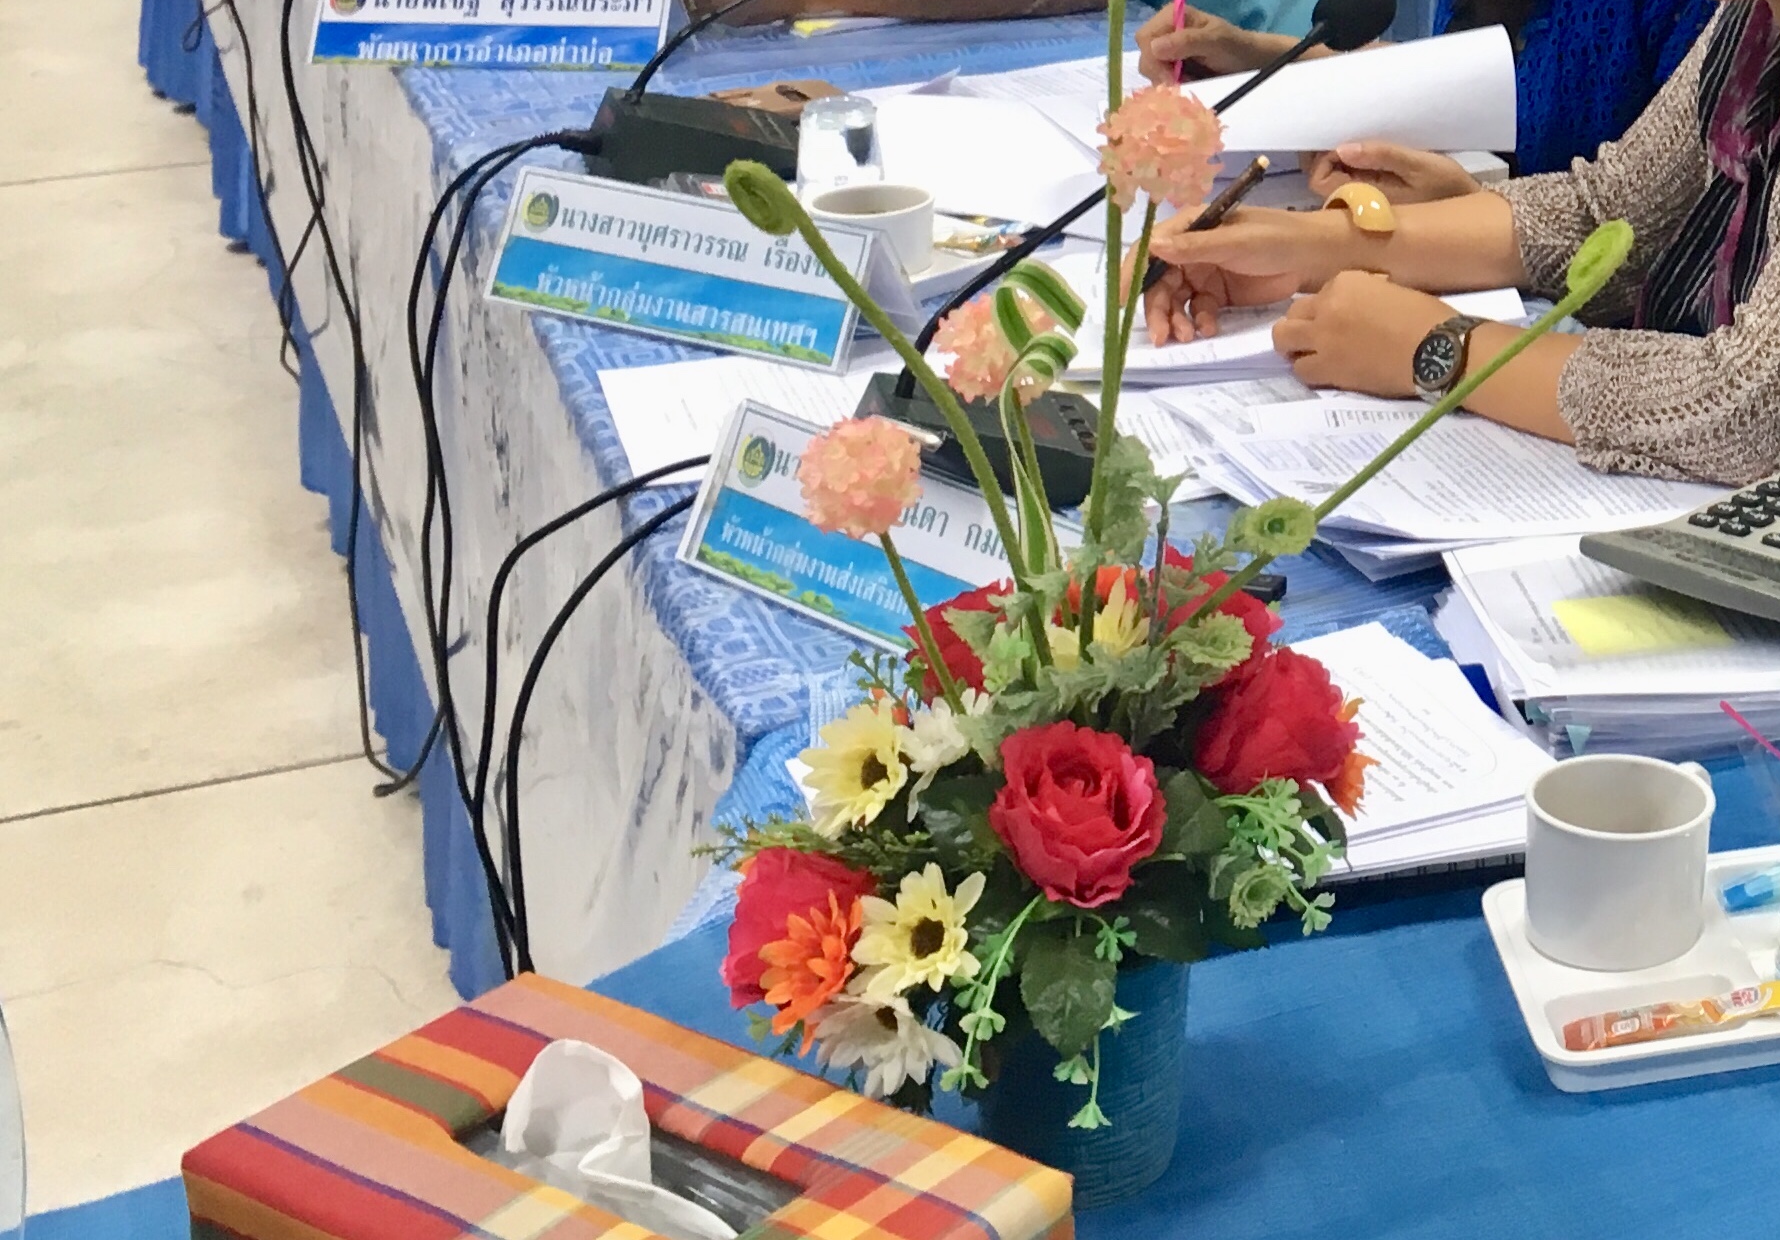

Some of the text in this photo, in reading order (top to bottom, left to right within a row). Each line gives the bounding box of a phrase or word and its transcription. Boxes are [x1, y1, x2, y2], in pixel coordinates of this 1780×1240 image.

[357, 33, 614, 65] พัฒนาการอำเภอท่าบ่อ
[560, 206, 750, 263] นางสาวบุศราวรรณ
